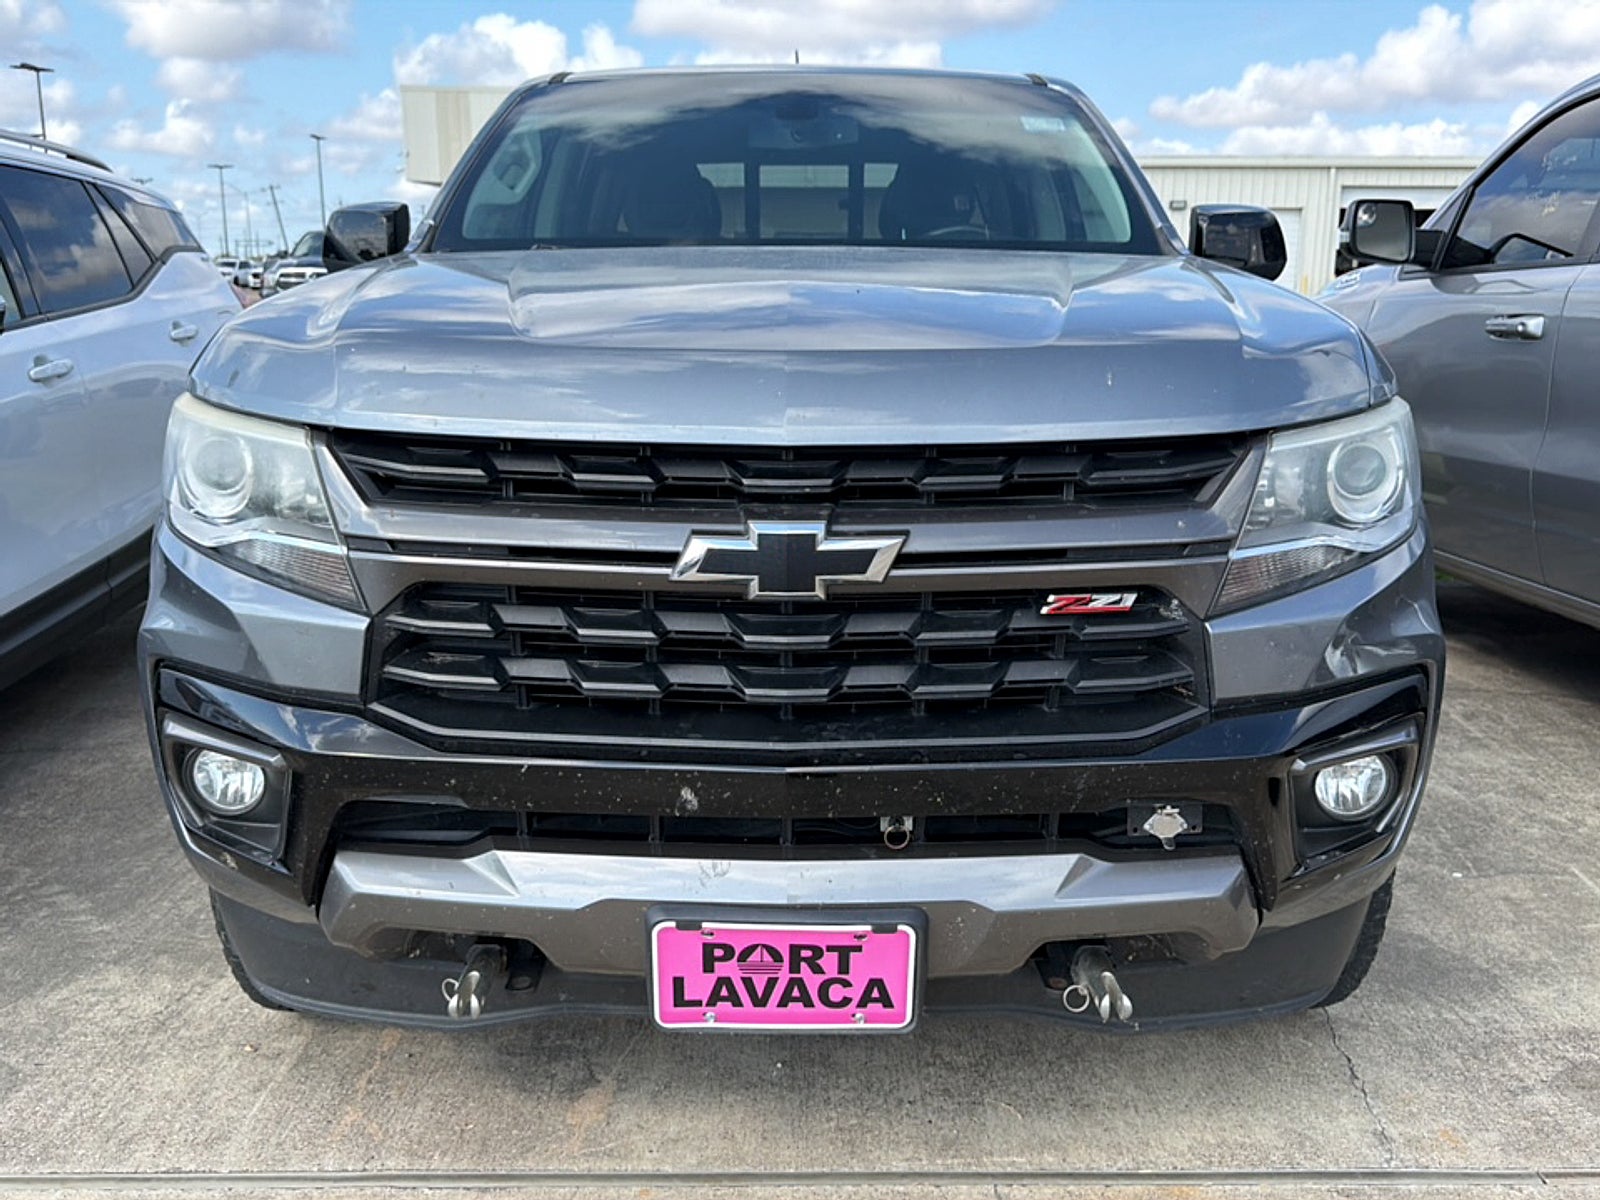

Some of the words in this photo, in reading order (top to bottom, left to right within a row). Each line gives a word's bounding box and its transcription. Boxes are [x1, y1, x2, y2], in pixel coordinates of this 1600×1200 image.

[1040, 593, 1138, 615] Z71
[702, 942, 863, 975] PORT
[673, 976, 895, 1009] LAVACA
